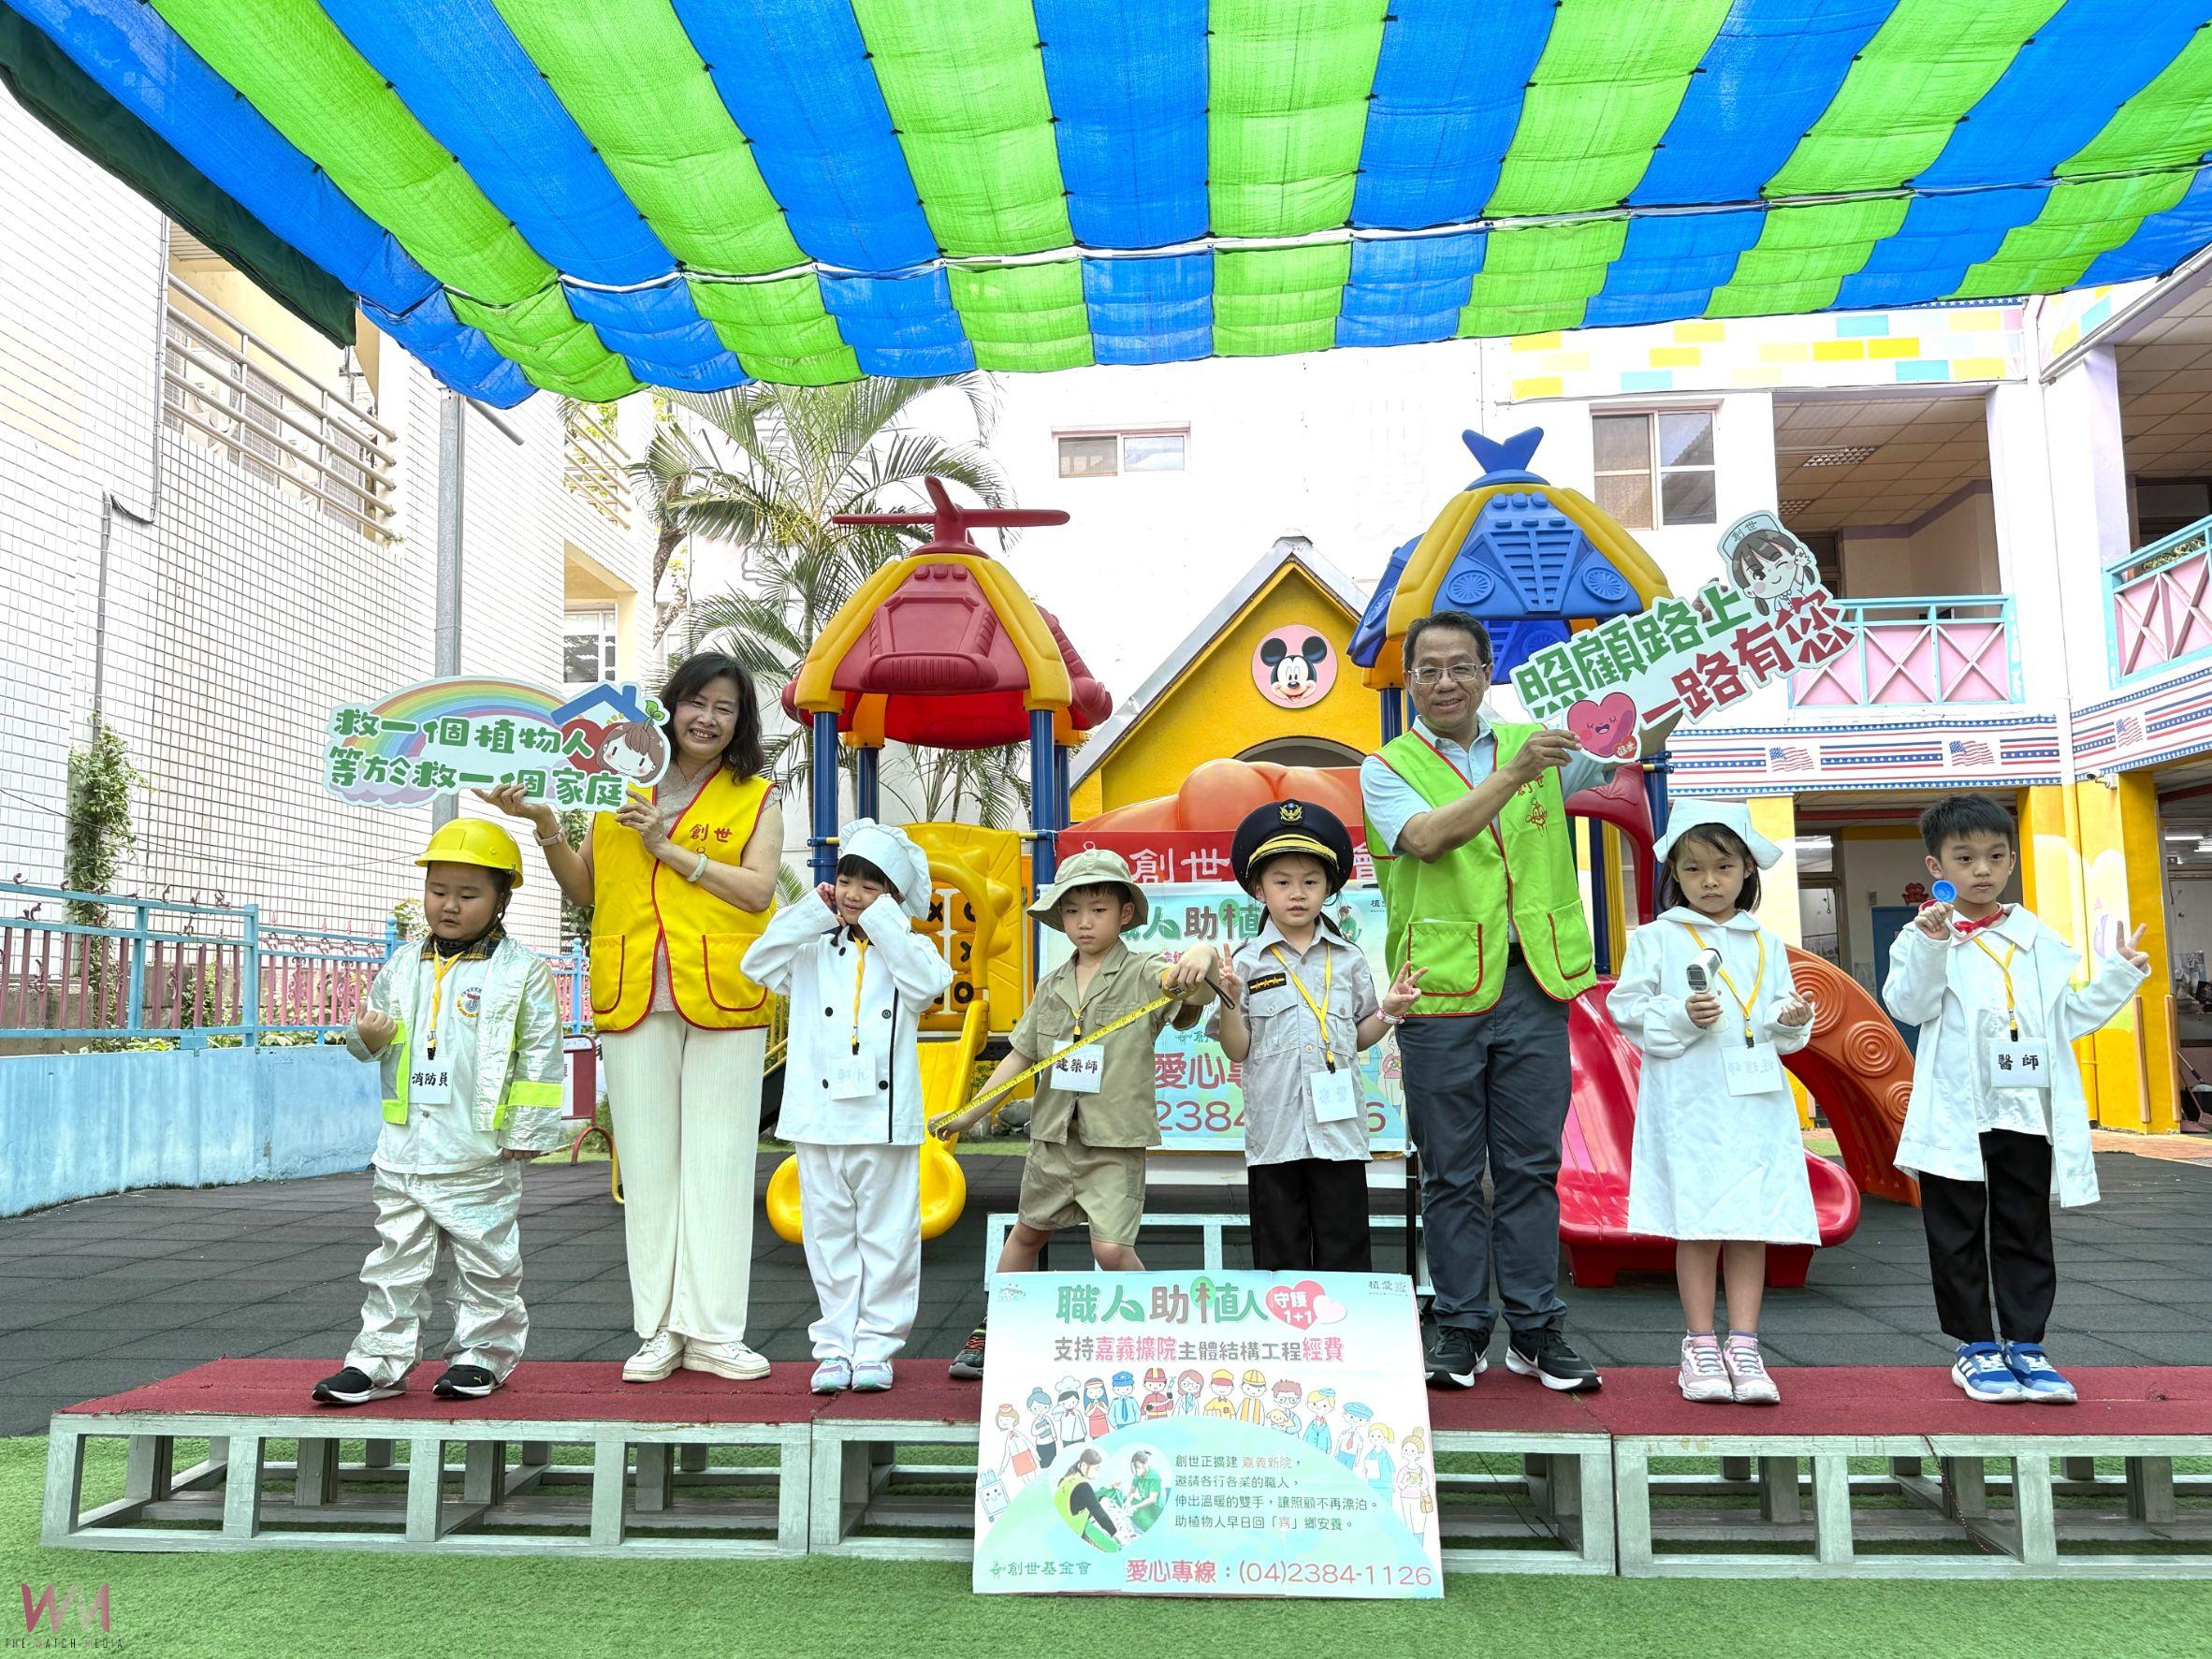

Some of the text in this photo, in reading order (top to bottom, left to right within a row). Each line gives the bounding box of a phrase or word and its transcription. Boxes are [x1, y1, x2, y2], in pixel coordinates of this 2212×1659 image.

[1515, 586, 1753, 720] 照顧路上
[1641, 589, 1857, 725] 一路有您
[333, 708, 594, 760] 救一個植物人
[328, 749, 624, 808] 等於救一個家庭
[689, 822, 733, 843] 創世
[1120, 902, 1260, 941] 人助植
[1055, 1057, 1098, 1074] 建築師
[1998, 1054, 2039, 1070] 醫師
[412, 1071, 448, 1086] 消防員
[1056, 1282, 1270, 1324] 職人助植人
[1284, 1310, 1312, 1325] 1+1
[1054, 1335, 1345, 1361] 支持嘉義擴院主體結構工程經費
[1008, 1561, 1092, 1576] 創世基金會
